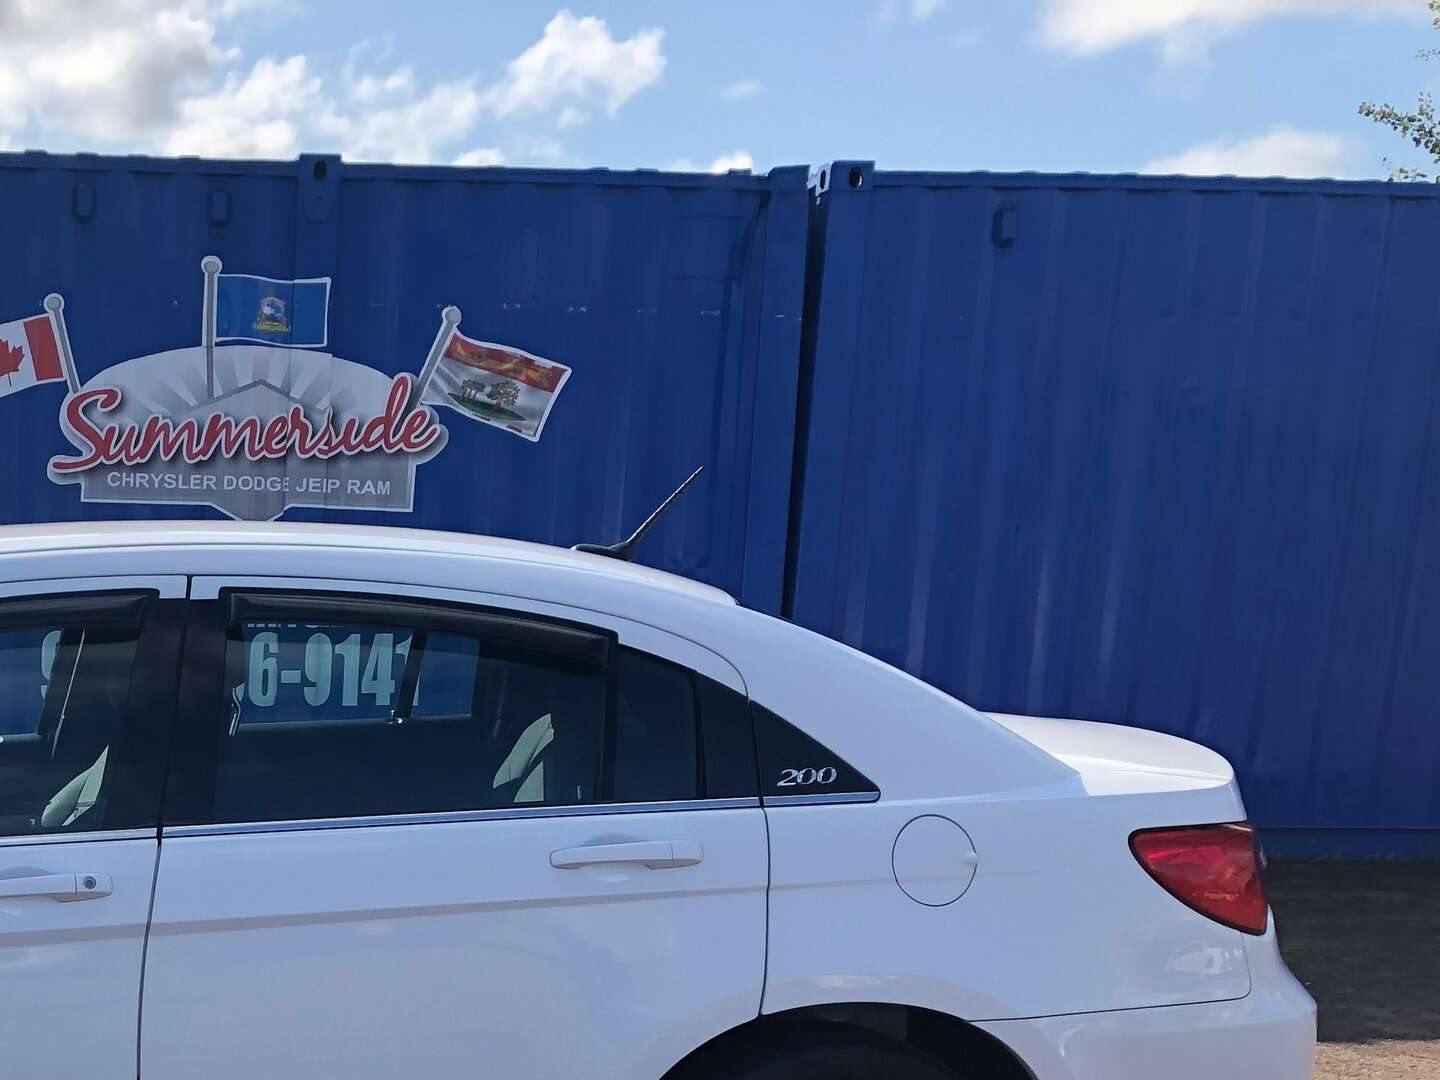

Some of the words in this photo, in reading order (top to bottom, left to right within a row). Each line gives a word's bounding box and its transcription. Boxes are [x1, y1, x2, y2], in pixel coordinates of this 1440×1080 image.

[51, 374, 441, 472] Summerside
[106, 471, 217, 490] CHRYSLER
[223, 474, 290, 492] DODGE
[346, 479, 391, 495] RAM
[776, 766, 838, 787] 200
